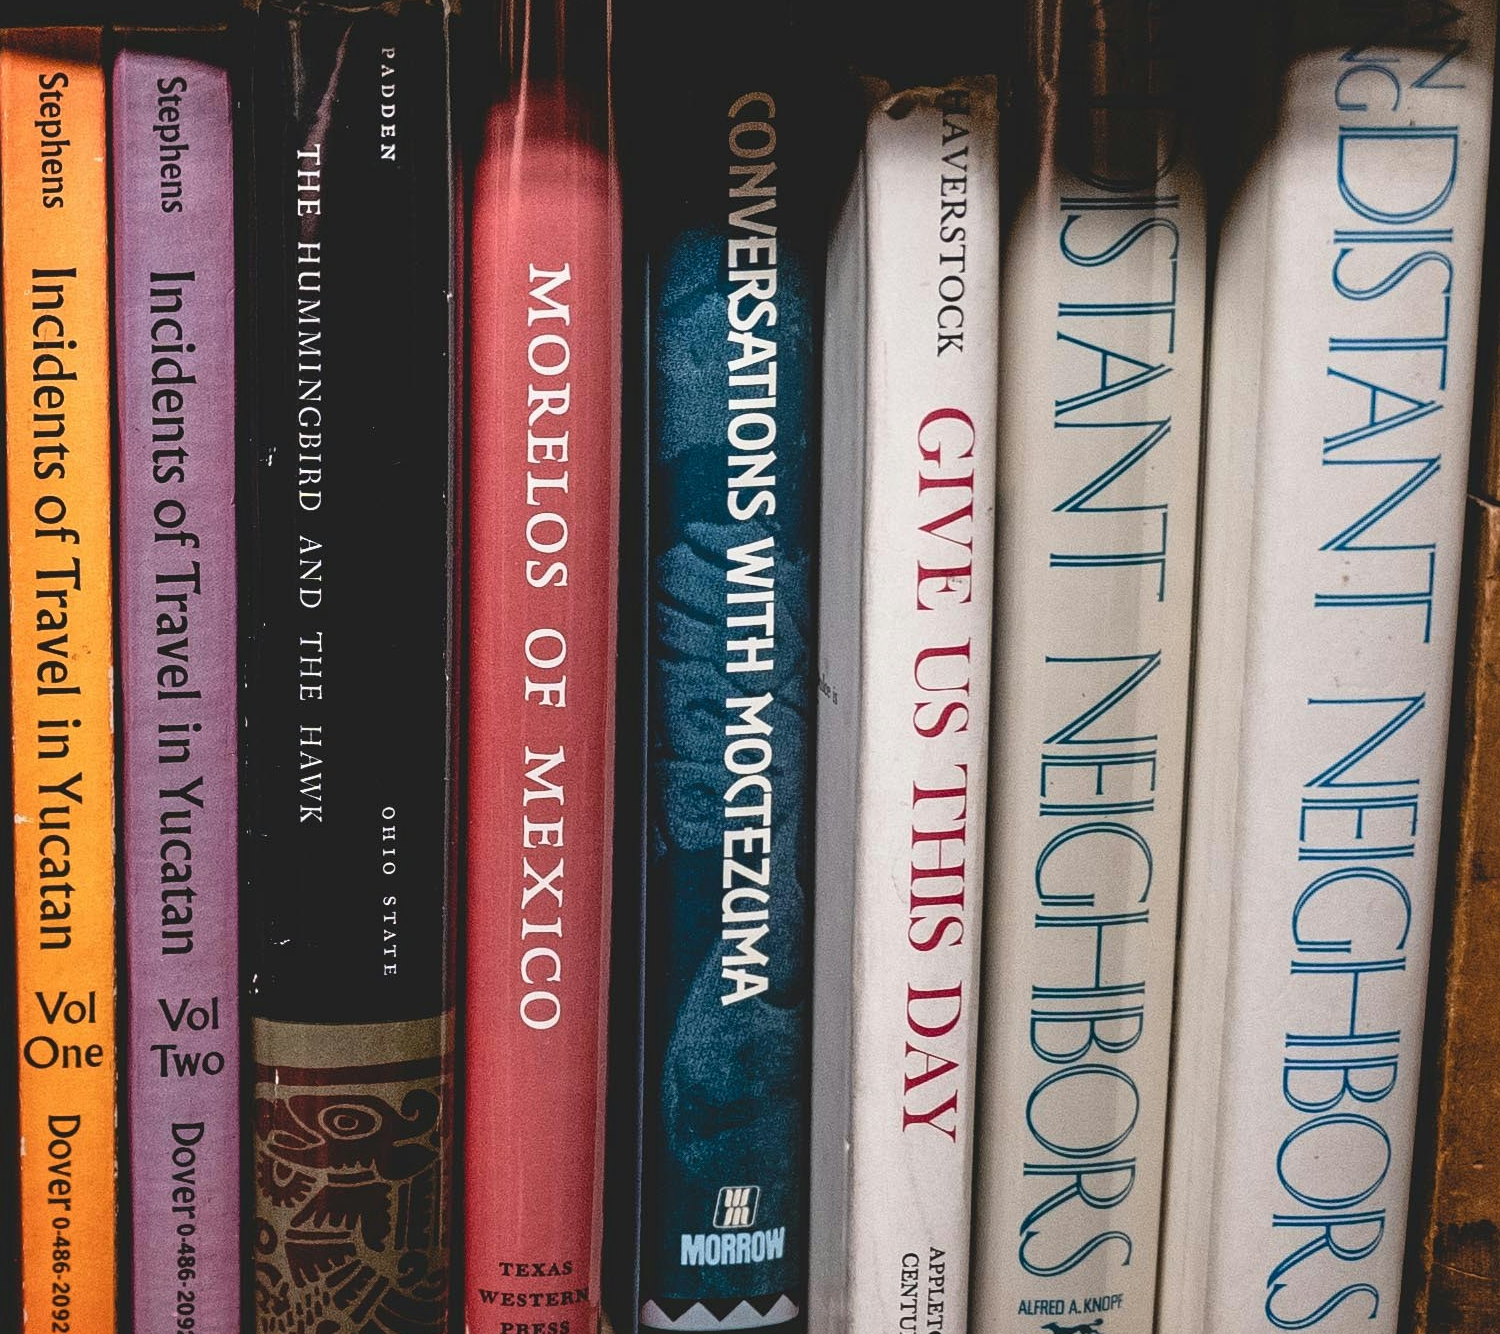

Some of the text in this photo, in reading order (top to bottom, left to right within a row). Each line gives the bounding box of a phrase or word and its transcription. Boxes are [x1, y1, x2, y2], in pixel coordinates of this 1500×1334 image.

[34, 73, 69, 209] Stephens
[30, 267, 83, 950] Incidents of Travel in Yucatan
[297, 144, 323, 823] THE HUMMINGBIRD AND THE HAWK
[519, 264, 570, 1031] MORELOS OF MEXICO
[721, 92, 777, 1006] CONVERSATIONS WITH MOCTEZUMA
[902, 408, 976, 1143] GIVE US THIS DAY
[23, 1038, 103, 1070] One
[35, 992, 97, 1024] Vol
[680, 1228, 784, 1266] MORROW
